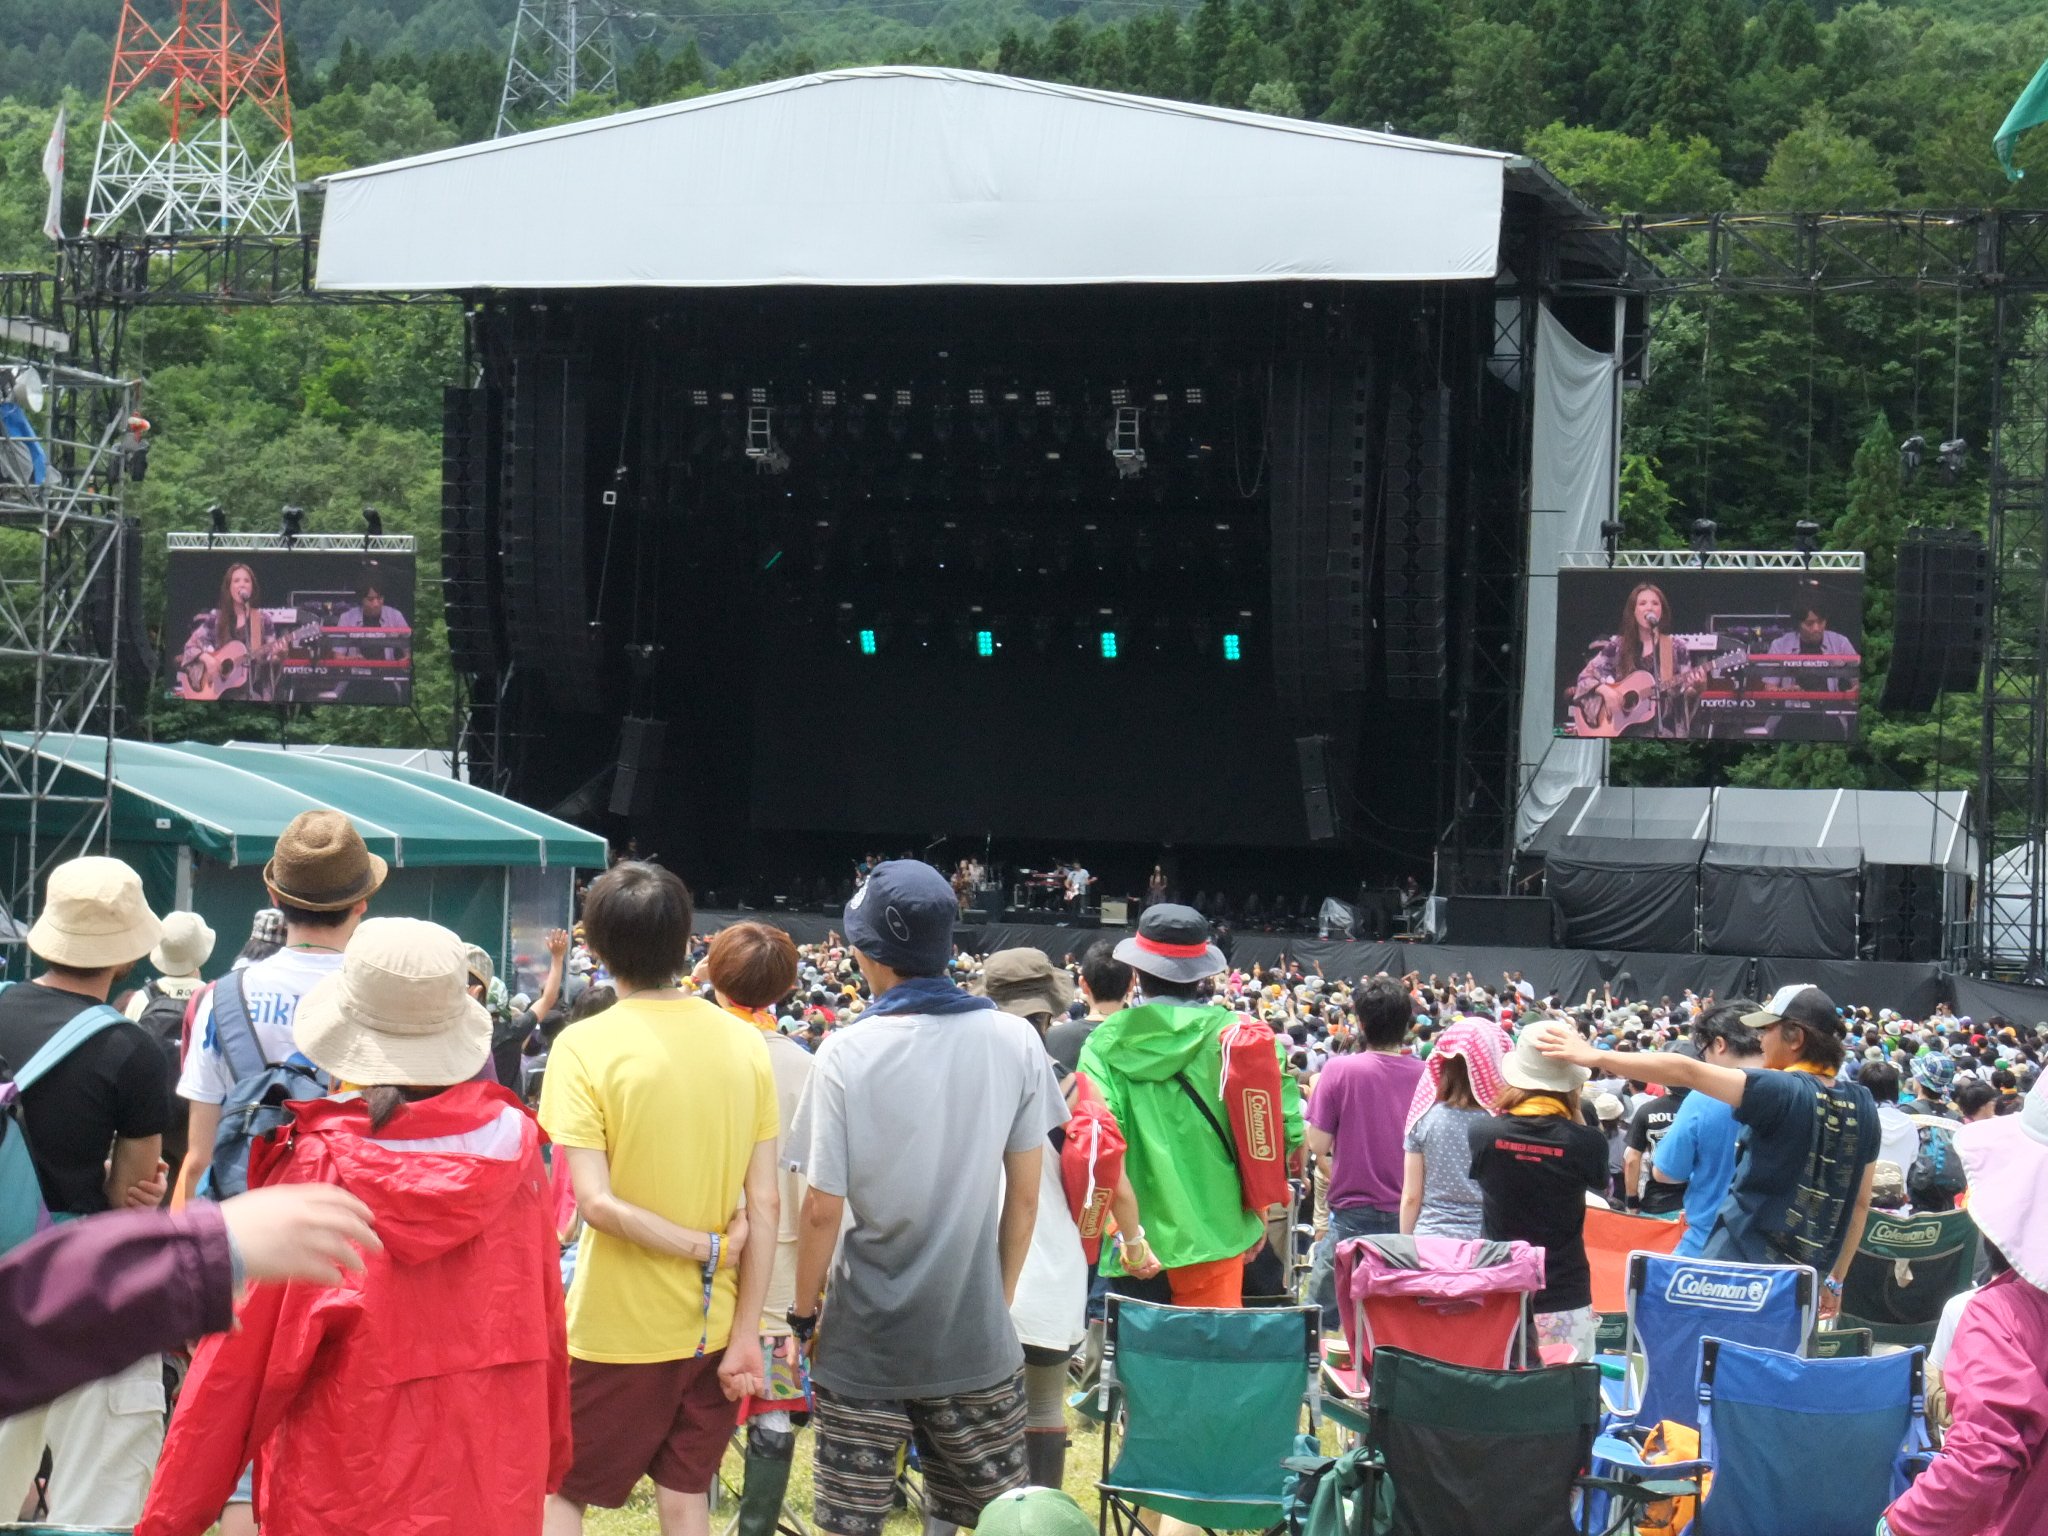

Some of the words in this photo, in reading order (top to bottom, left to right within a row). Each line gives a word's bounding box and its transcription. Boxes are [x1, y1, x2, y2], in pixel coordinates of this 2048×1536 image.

[1250, 1094, 1268, 1146] Coleman
[1876, 1224, 1925, 1242] Coleman
[1677, 1273, 1748, 1300] Coleman
